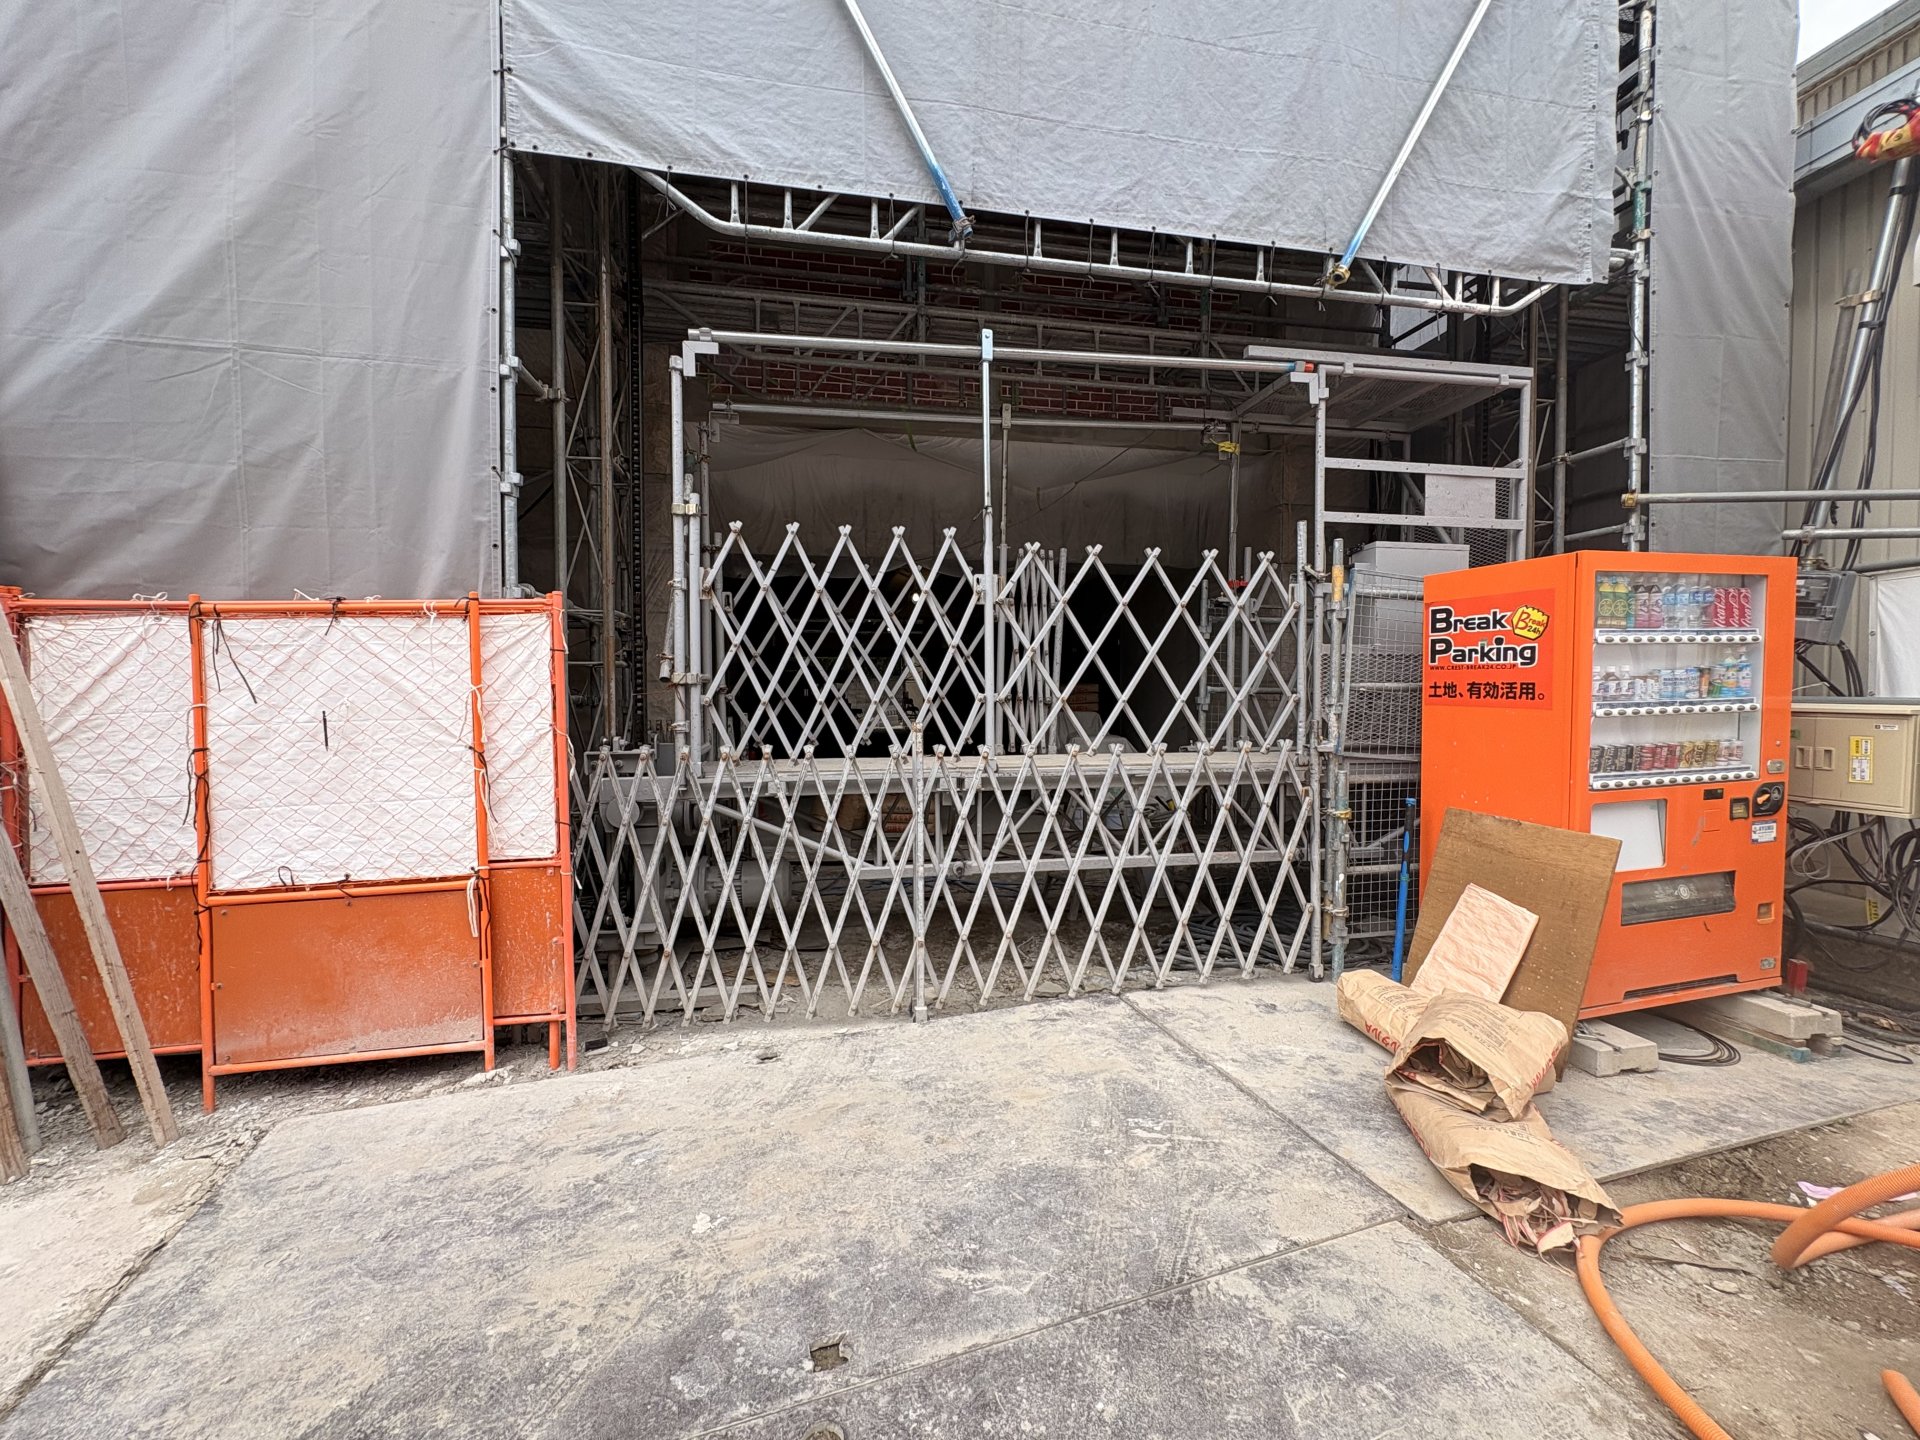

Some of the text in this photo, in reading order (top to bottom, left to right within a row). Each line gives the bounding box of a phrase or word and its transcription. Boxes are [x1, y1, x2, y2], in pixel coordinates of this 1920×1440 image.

[1430, 607, 1510, 634] Break
[1515, 610, 1545, 630] Break
[1527, 625, 1541, 634] 24h
[1430, 636, 1537, 667] Parking
[1428, 681, 1545, 700] 土地、有効活用。
